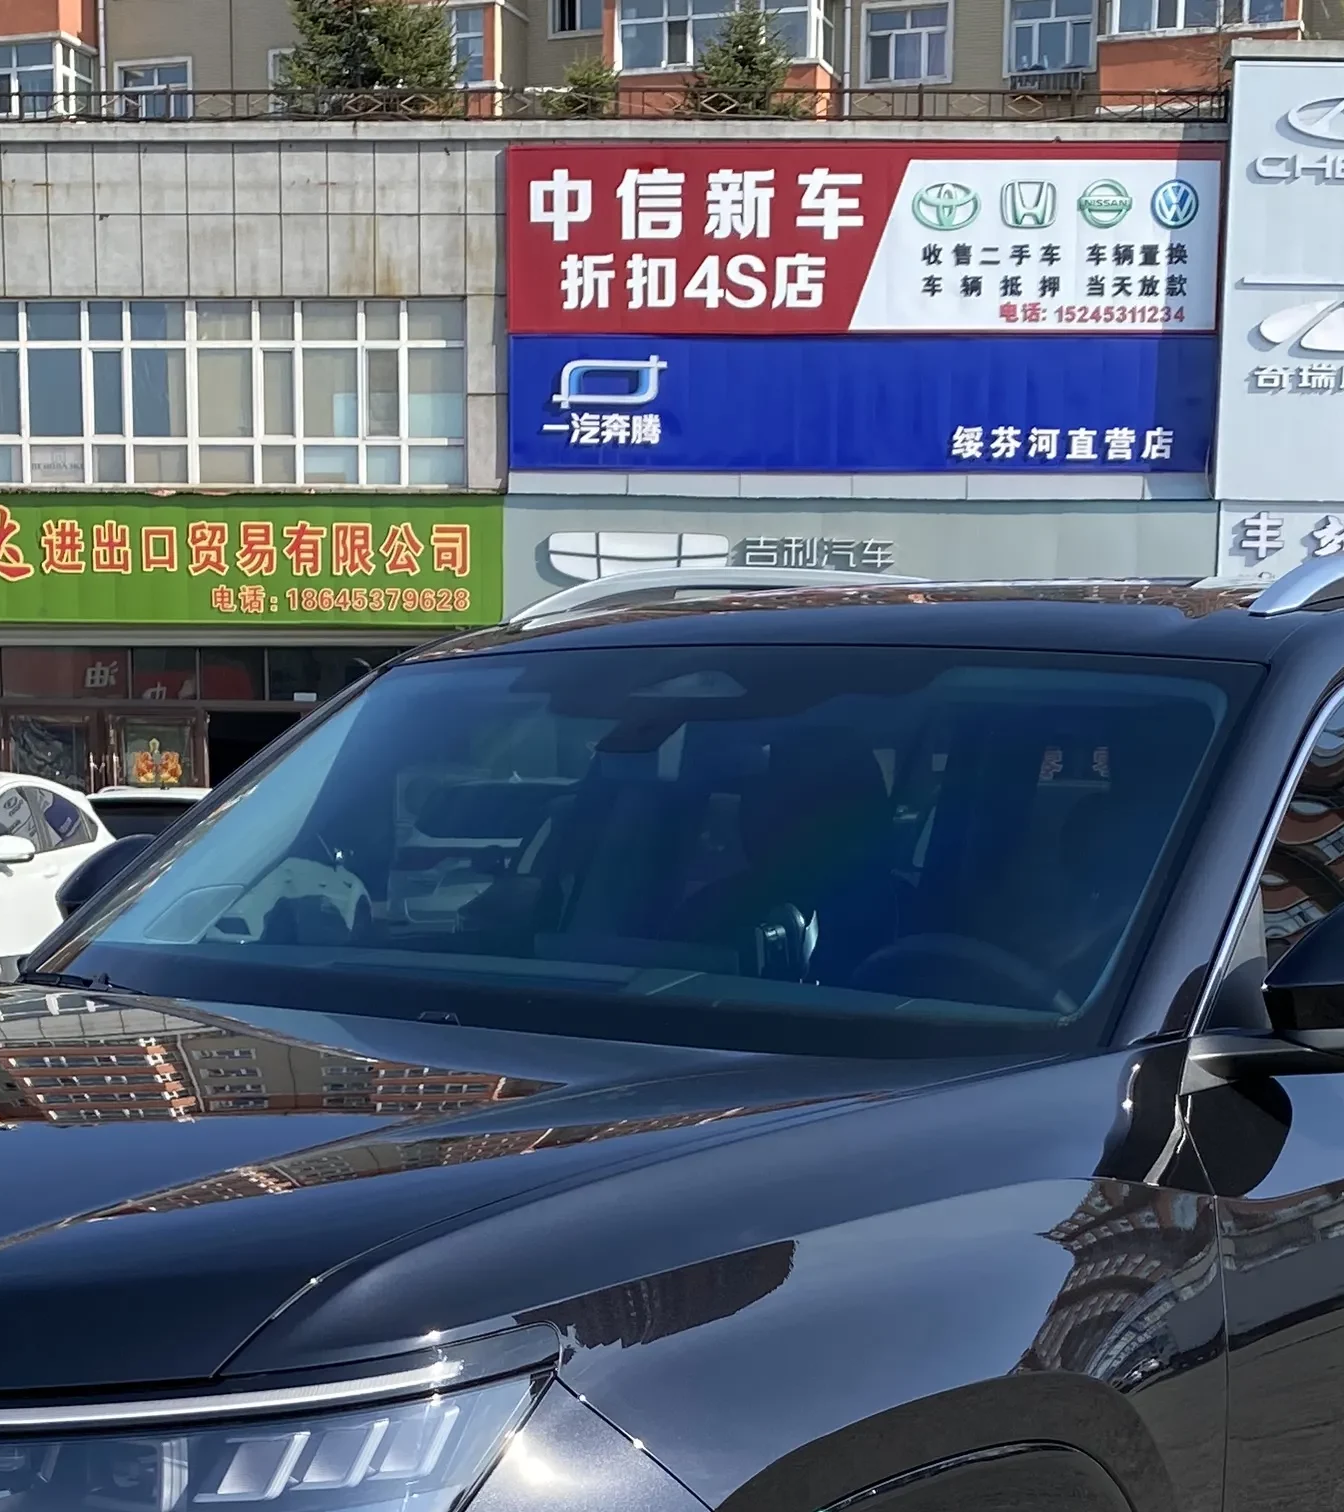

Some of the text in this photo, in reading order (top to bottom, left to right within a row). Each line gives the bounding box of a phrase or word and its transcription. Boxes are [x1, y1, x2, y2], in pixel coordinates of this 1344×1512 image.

[529, 167, 864, 242] 中信新车
[1080, 199, 1131, 208] NISSAN
[921, 243, 1189, 268] 收售二手车 车辆置换
[560, 253, 826, 310] 折扣4S店
[922, 274, 1188, 298] 车辆抵押 当天放款
[1054, 303, 1186, 324] 15245311234
[542, 412, 661, 445] 一汽奔腾
[952, 425, 1173, 460] 绥芬河直营店
[745, 536, 894, 568] 吉利汽车
[285, 587, 471, 613] 18645379628
